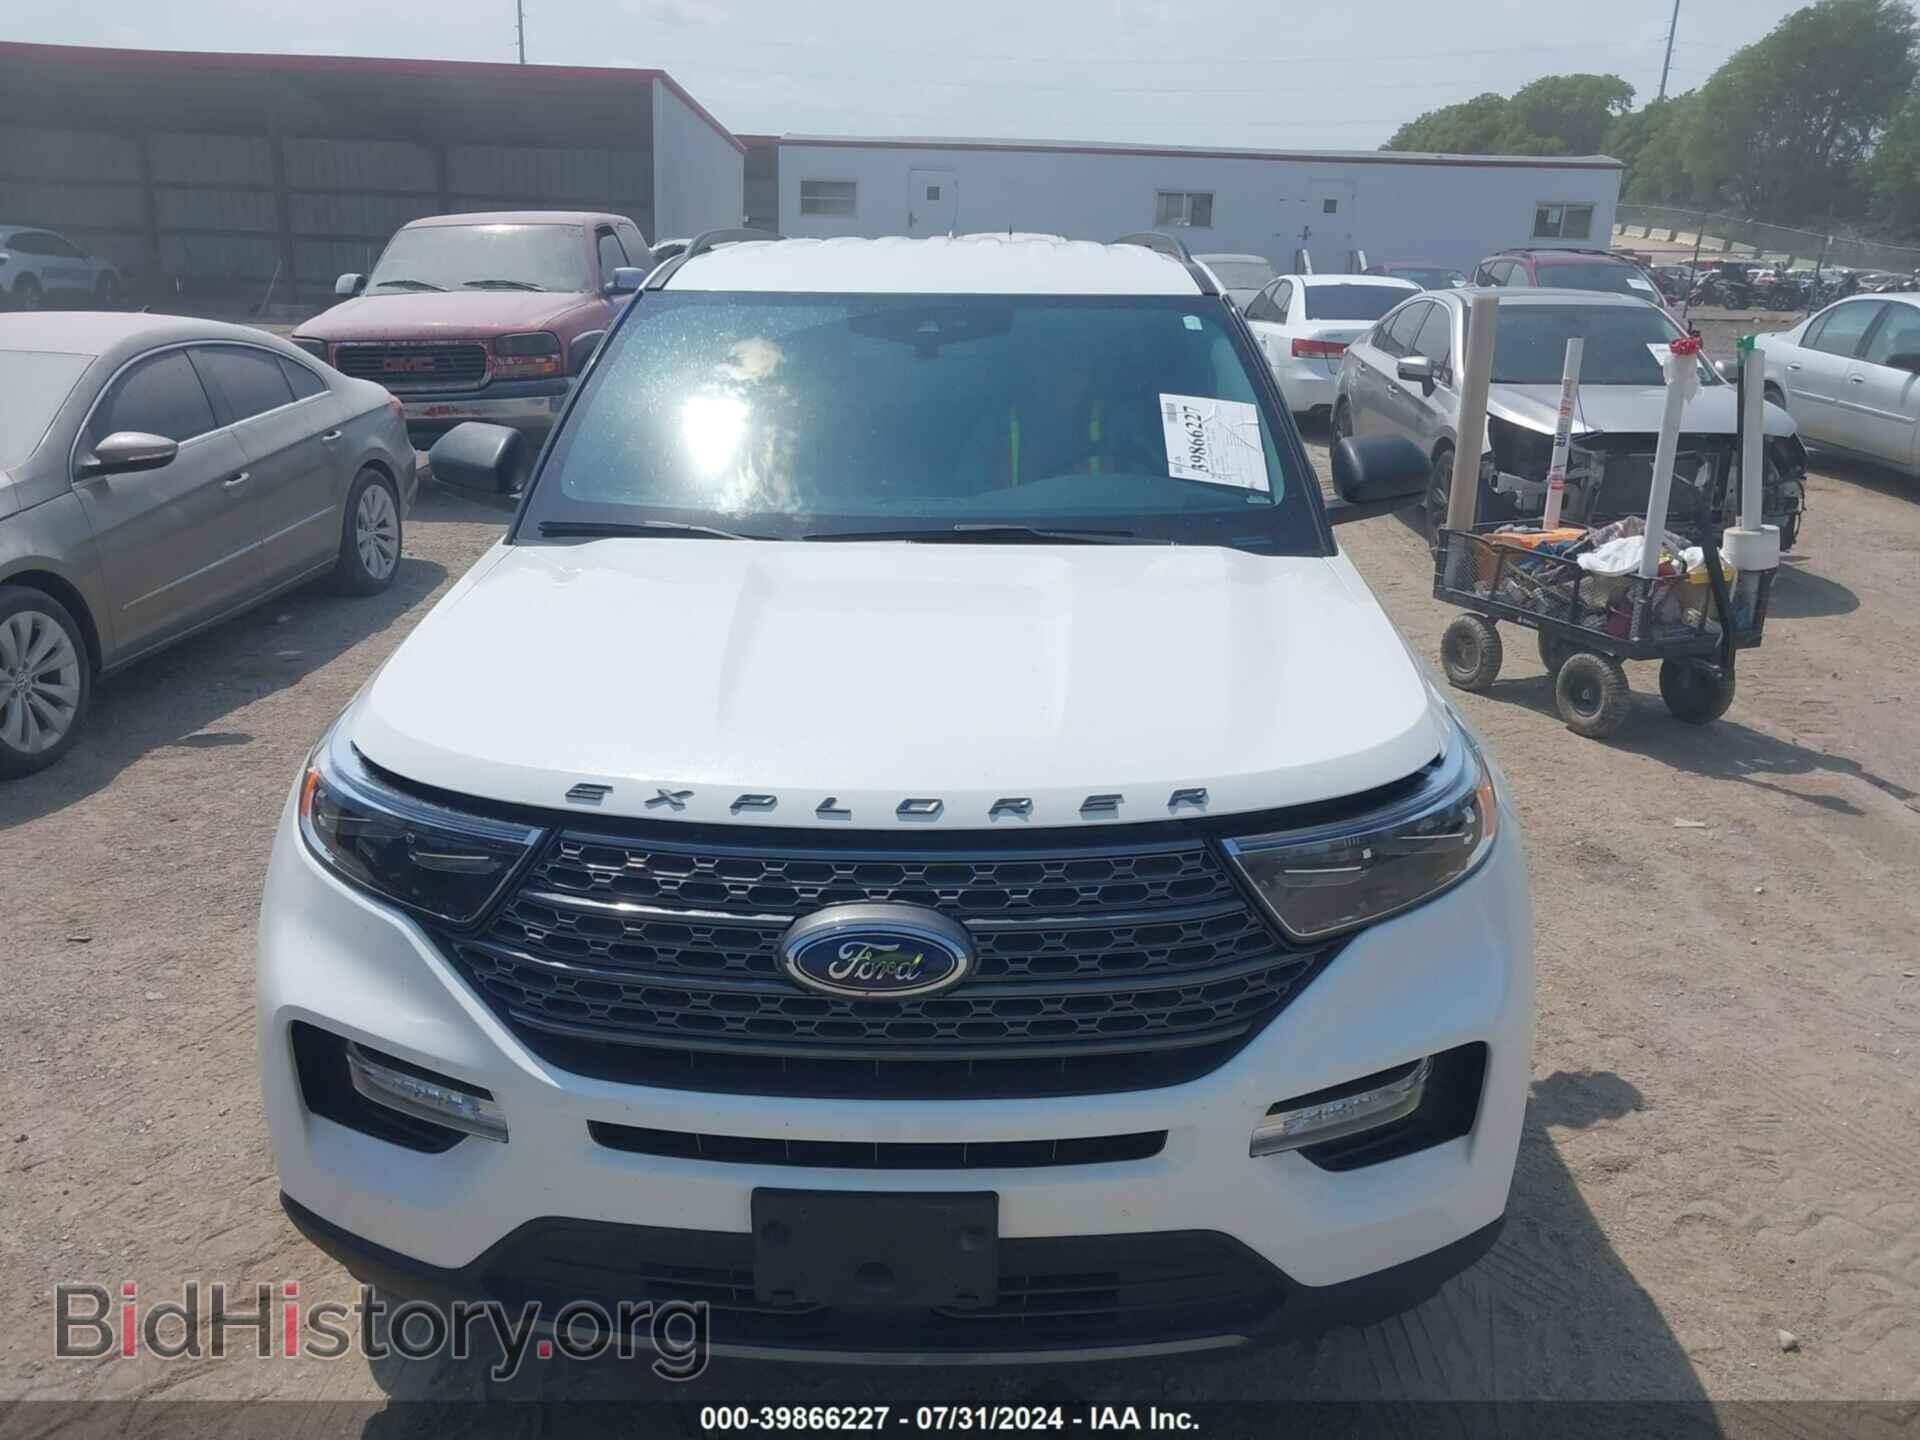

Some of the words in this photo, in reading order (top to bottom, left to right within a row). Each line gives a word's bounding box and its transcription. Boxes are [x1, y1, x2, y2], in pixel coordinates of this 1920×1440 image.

[382, 356, 435, 372] GMC
[1183, 405, 1210, 473] 39866227
[565, 783, 1208, 815] EXPLORER
[828, 941, 924, 981] Ford
